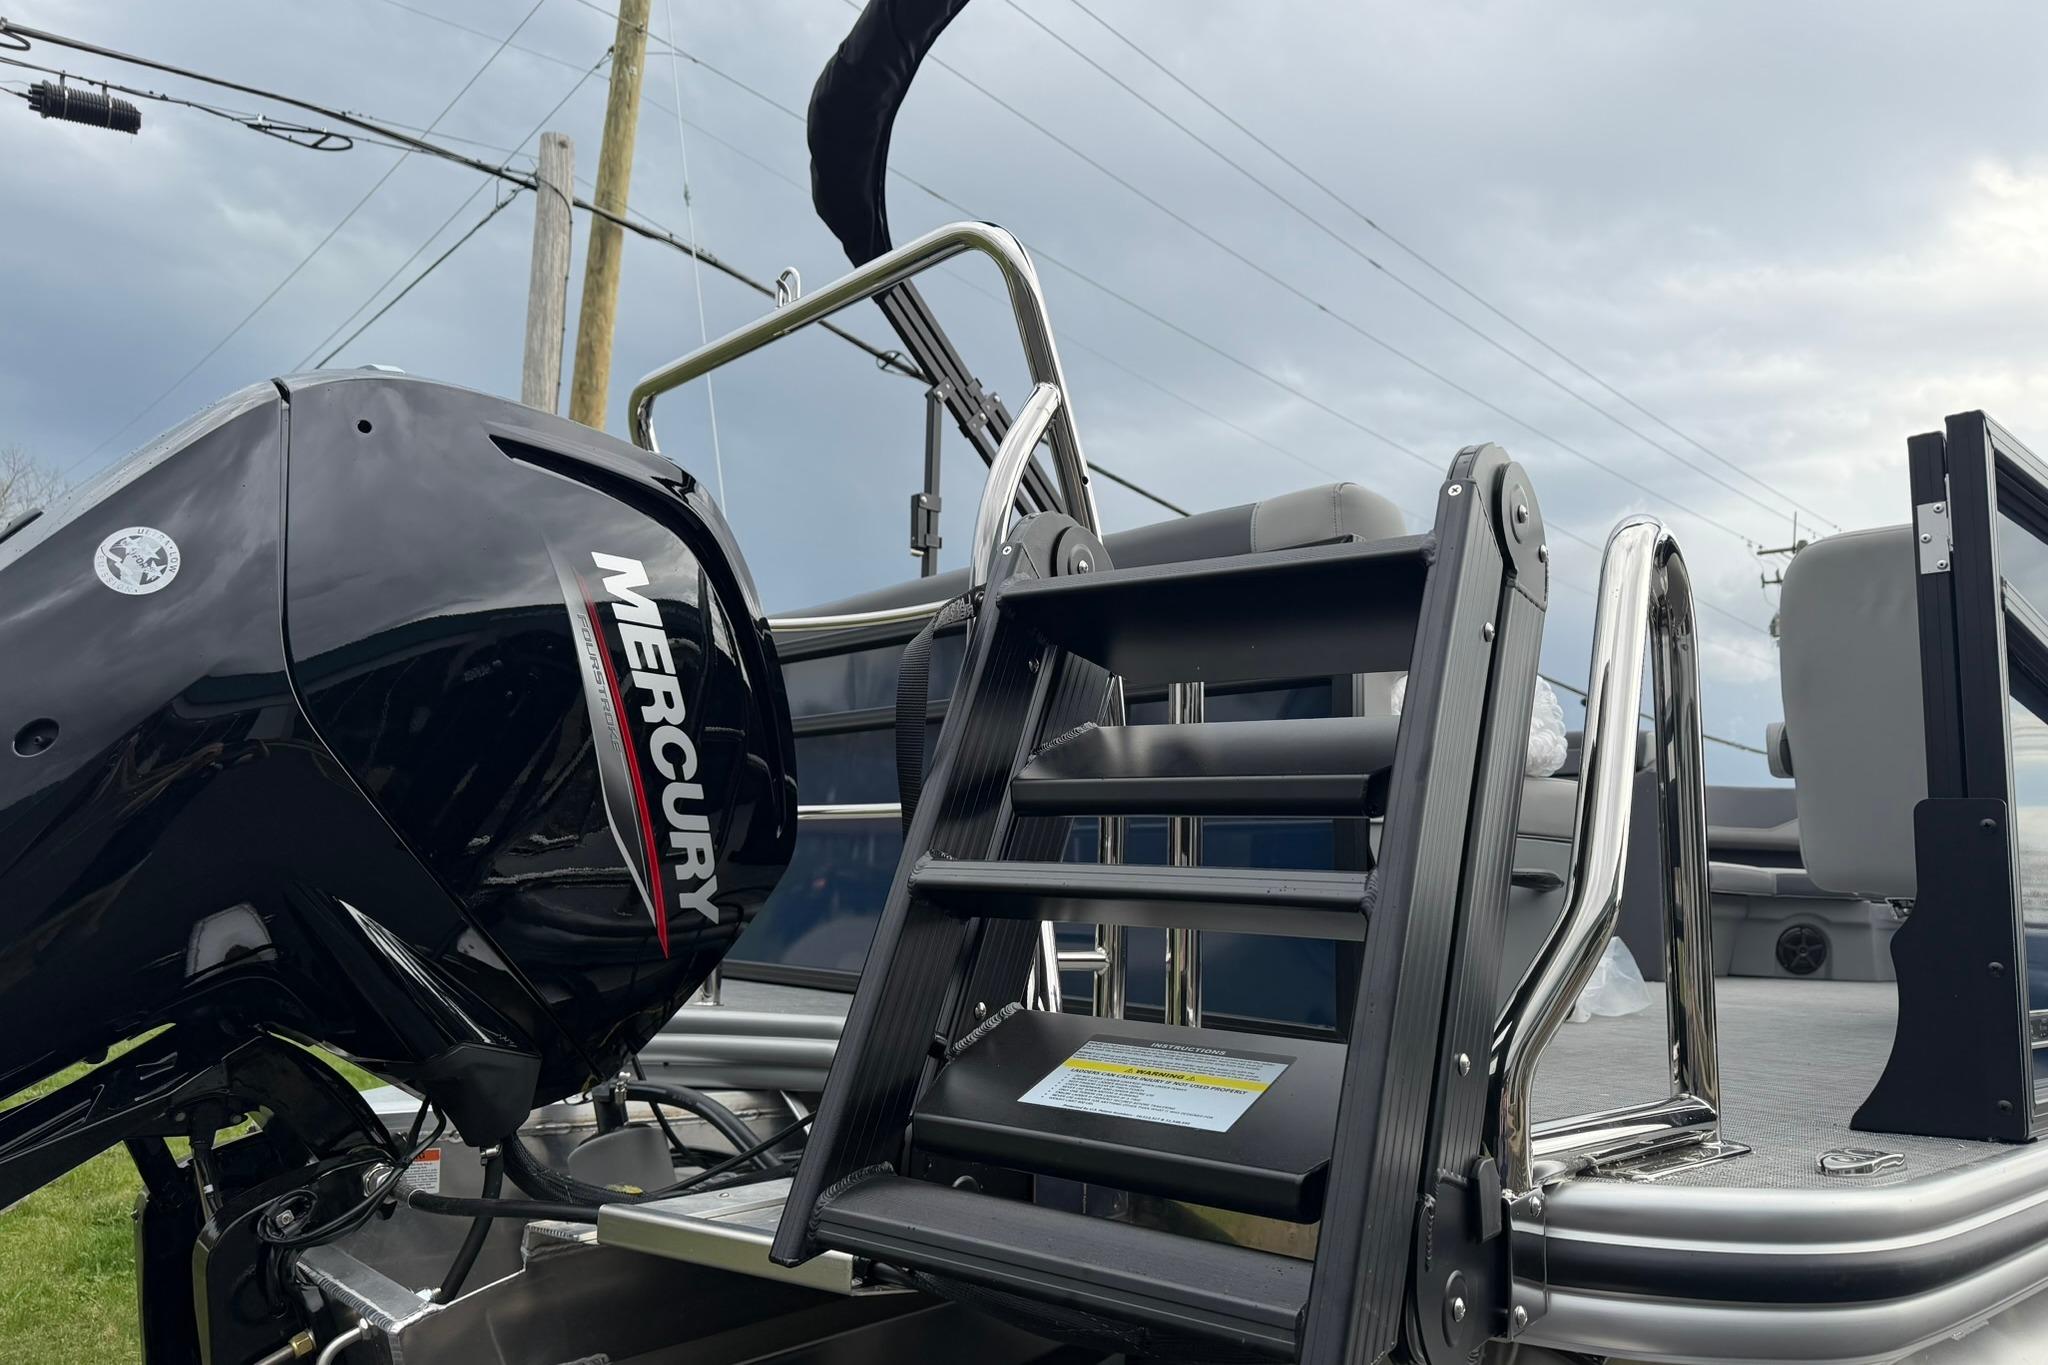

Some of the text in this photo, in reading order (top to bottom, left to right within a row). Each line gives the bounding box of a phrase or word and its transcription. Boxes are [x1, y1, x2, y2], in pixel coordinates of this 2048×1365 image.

[574, 612, 620, 753] FOURSTROKE
[591, 551, 720, 924] MERCURY
[1150, 1042, 1226, 1055] INSTRUCTIONS
[1136, 1069, 1185, 1079] WARNING
[1210, 1086, 1248, 1094] PROPERLY
